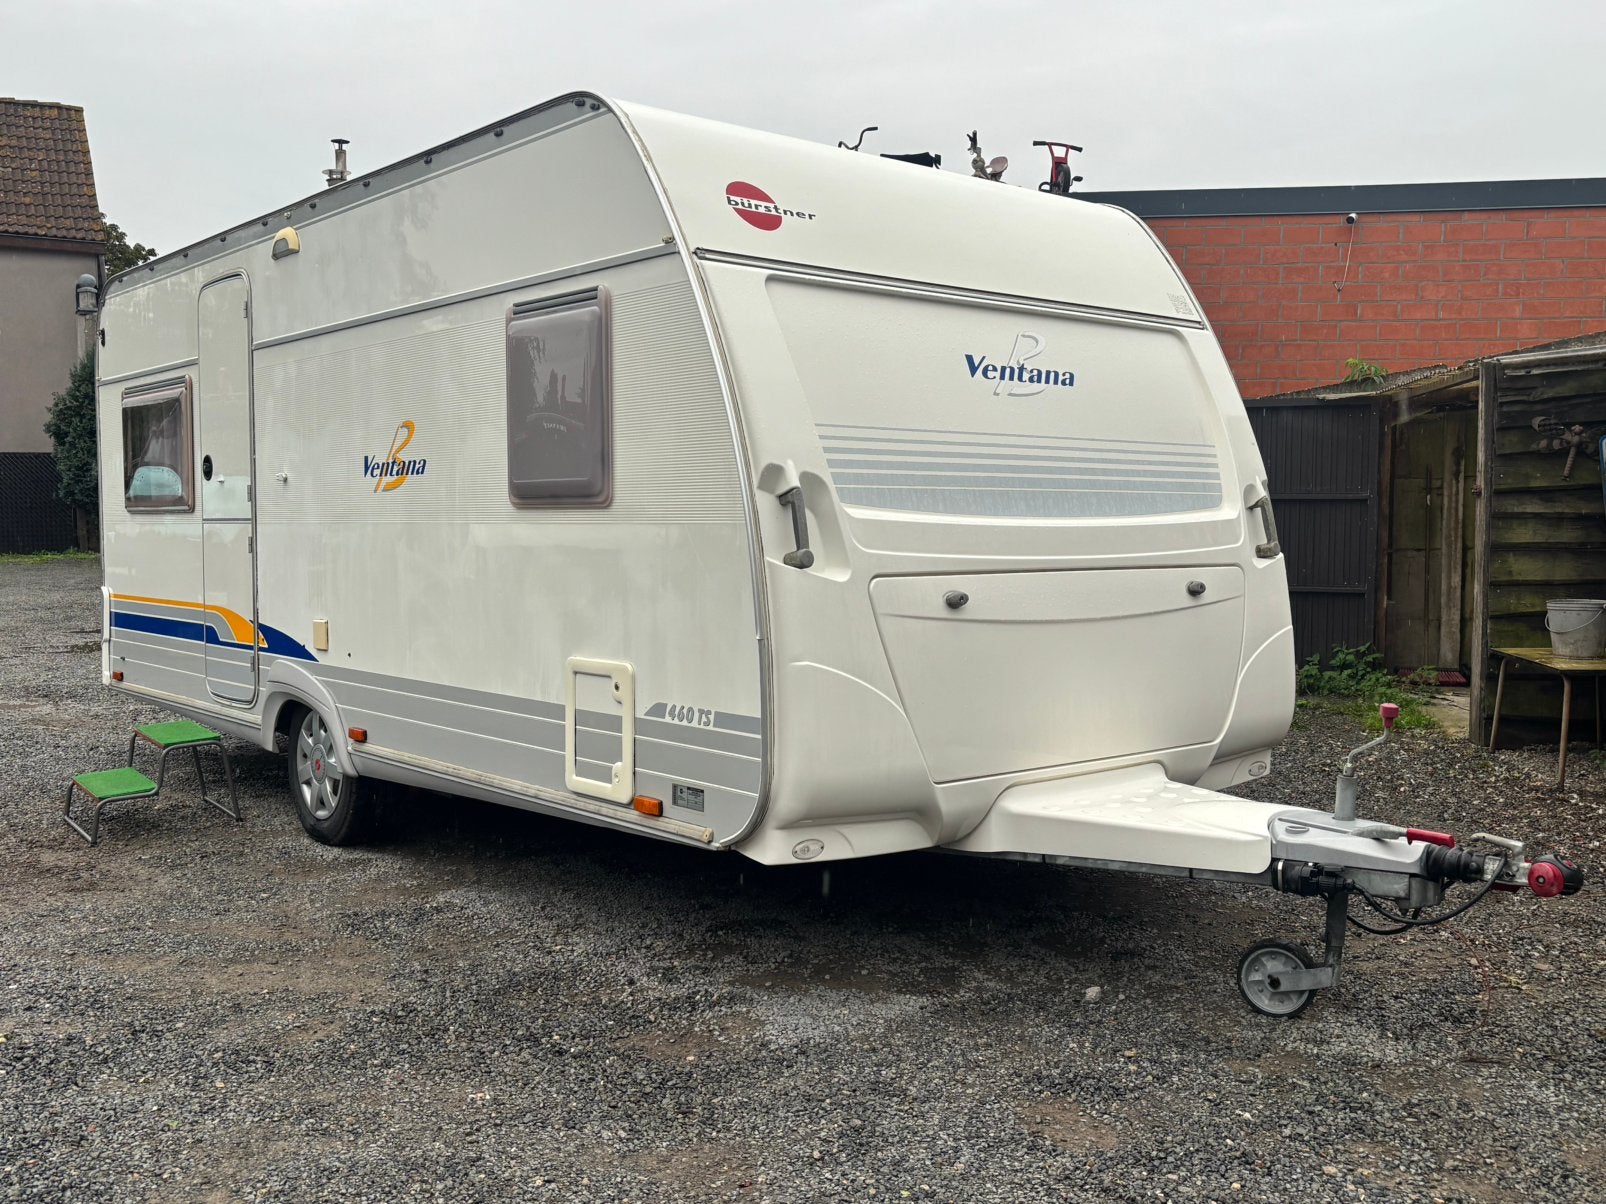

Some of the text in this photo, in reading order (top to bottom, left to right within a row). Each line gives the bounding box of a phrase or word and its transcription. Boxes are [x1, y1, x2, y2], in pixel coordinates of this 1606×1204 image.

[726, 196, 816, 220] bürstner
[964, 354, 1075, 387] Ventana
[364, 454, 427, 478] Ventana
[667, 703, 712, 727] 460 TS
